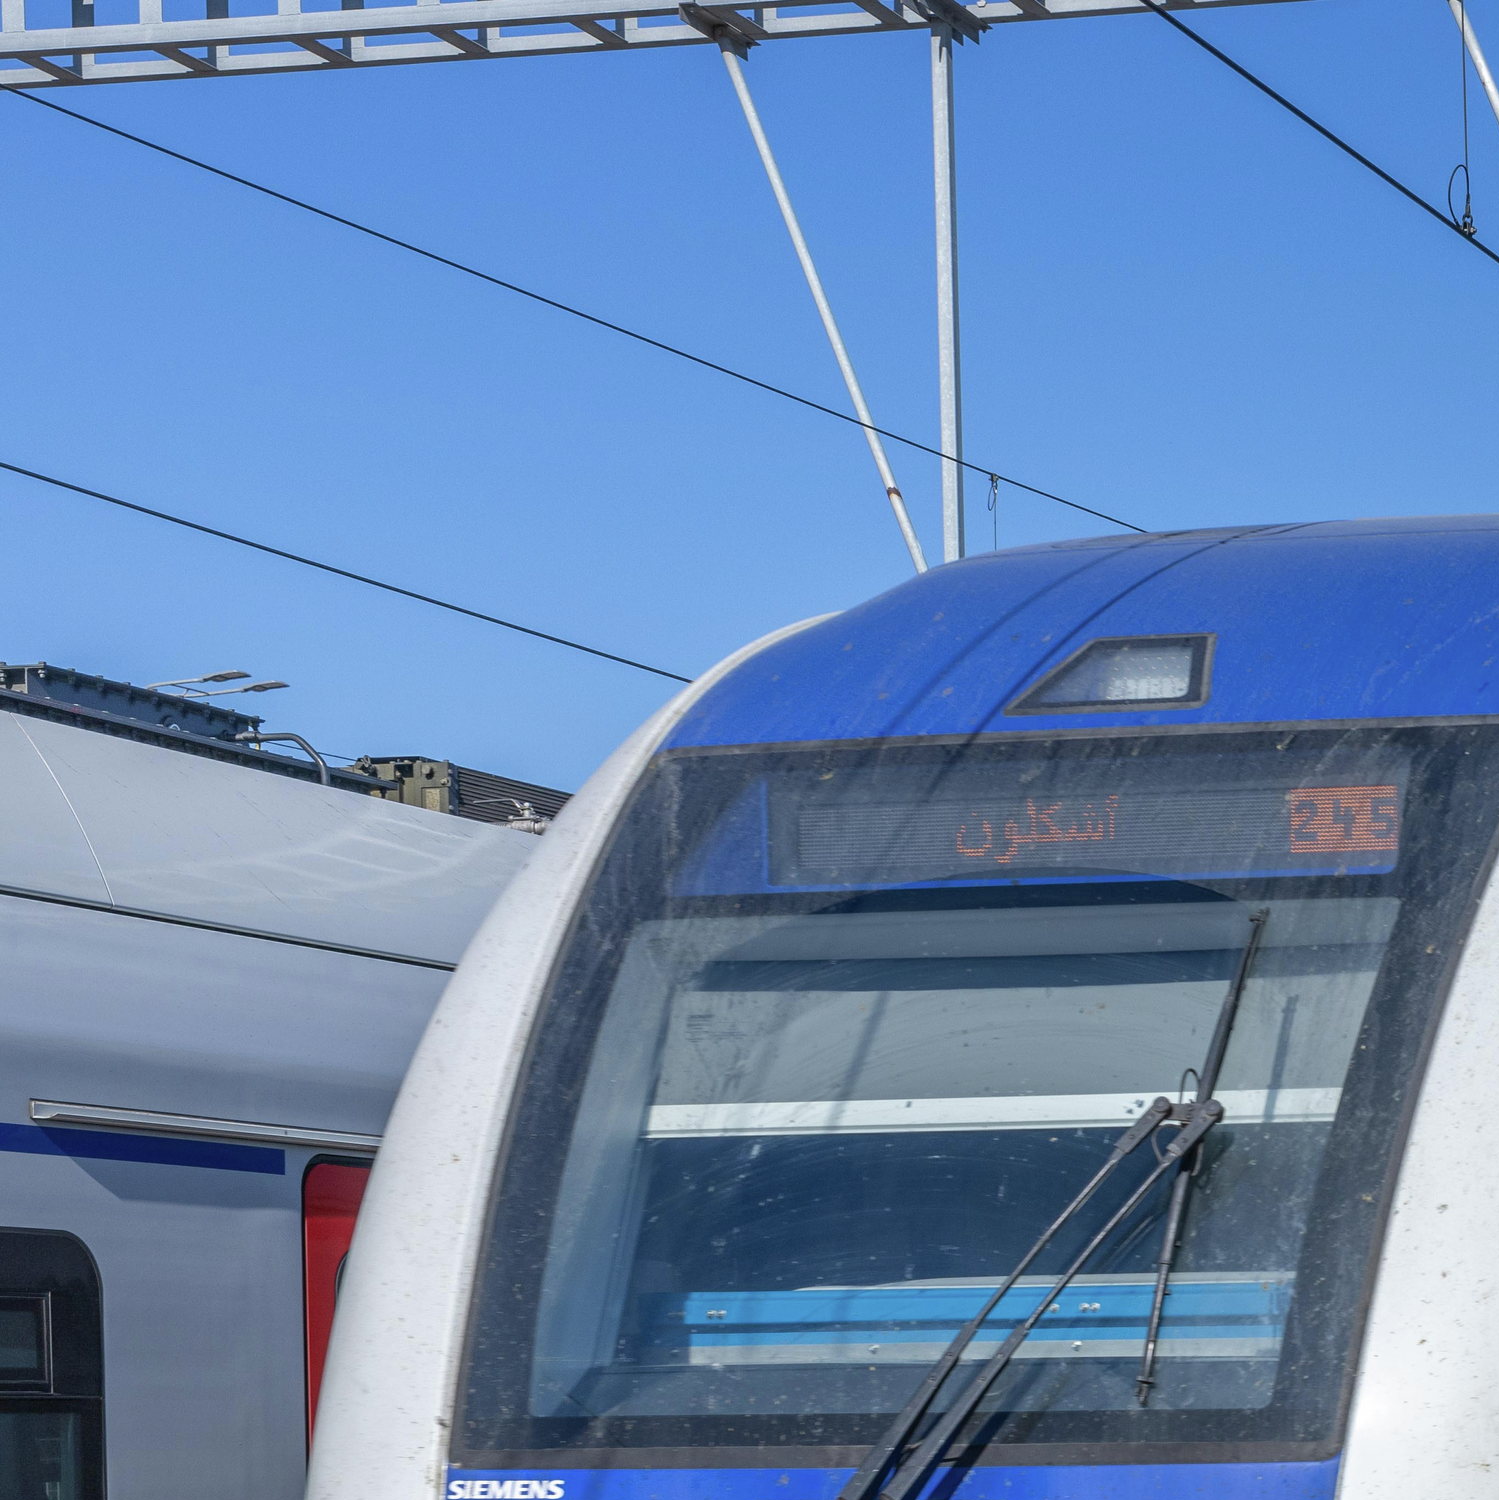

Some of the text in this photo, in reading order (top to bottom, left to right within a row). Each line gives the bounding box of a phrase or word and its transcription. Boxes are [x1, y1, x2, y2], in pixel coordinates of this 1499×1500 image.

[957, 795, 1118, 863] أشكلون
[1293, 796, 1397, 843] 245
[447, 1479, 565, 1500] SIEMENS
